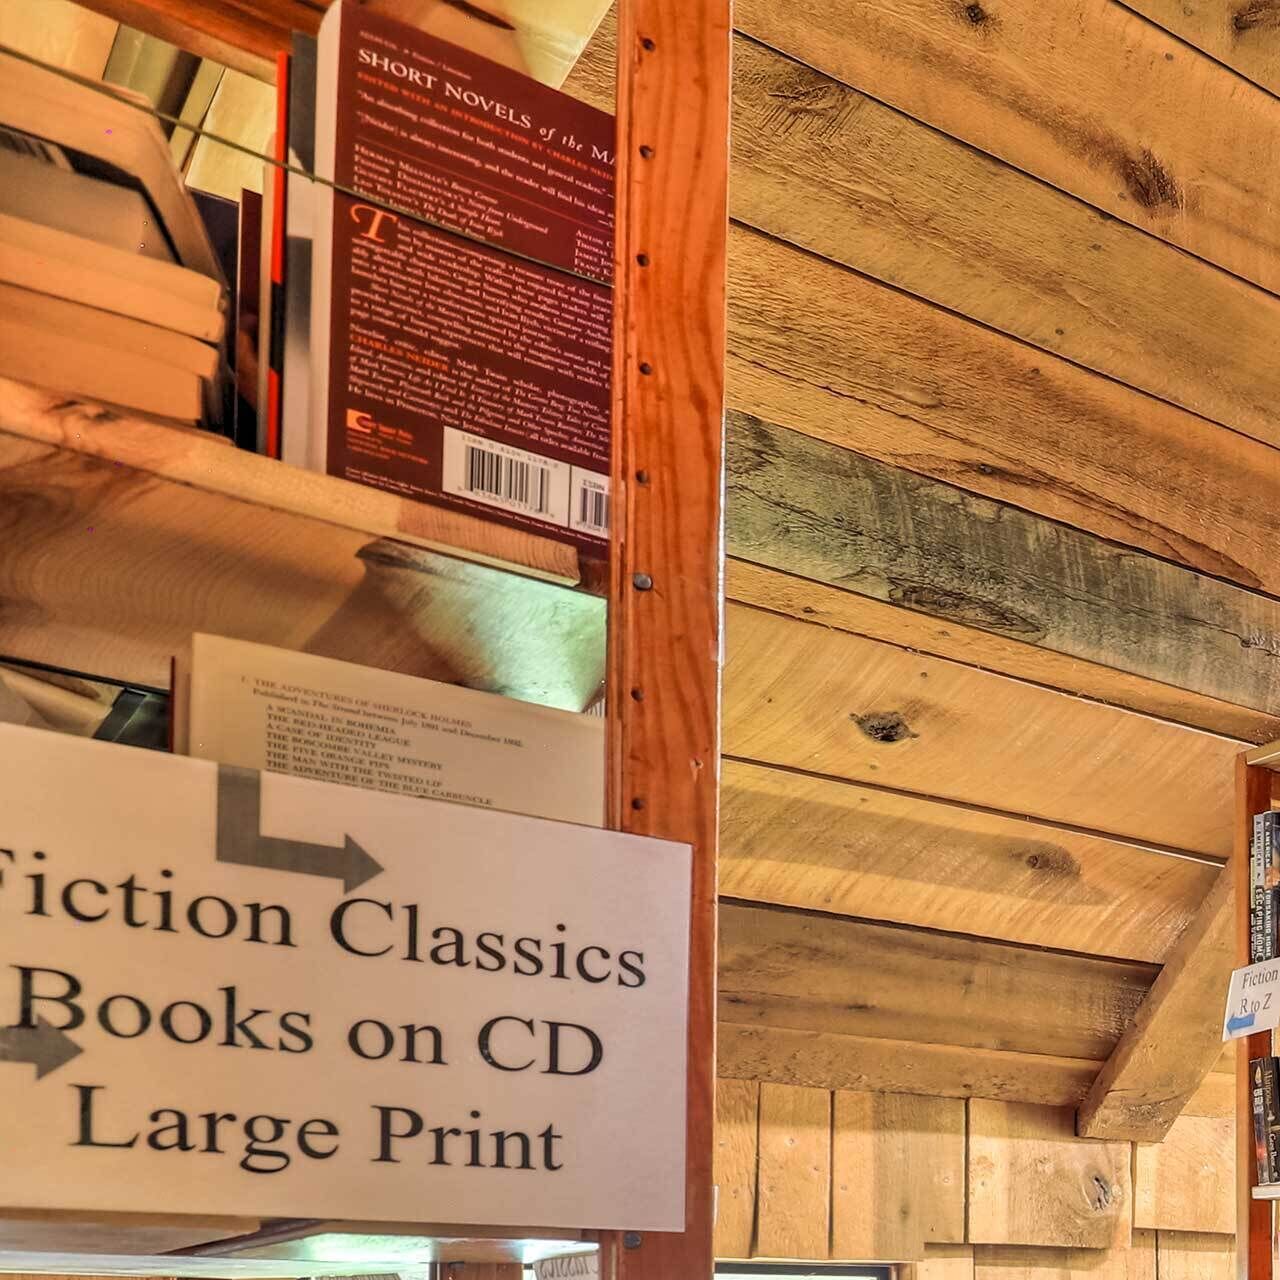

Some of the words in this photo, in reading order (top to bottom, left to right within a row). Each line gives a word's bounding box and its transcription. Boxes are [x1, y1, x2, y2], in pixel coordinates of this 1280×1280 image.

[357, 48, 438, 90] SHORT
[445, 82, 532, 129] NOVELS
[539, 126, 556, 142] of
[561, 134, 584, 152] the
[0, 848, 298, 948] iction
[330, 898, 647, 989] Classics
[8, 965, 314, 1054] Books
[347, 1017, 449, 1066] on
[477, 1015, 603, 1077] CD
[1240, 999, 1249, 1014] R
[1251, 998, 1260, 1012] to
[1263, 993, 1272, 1010] Z
[1242, 968, 1278, 989] Fiction
[67, 1084, 341, 1174] Large
[371, 1105, 564, 1172] Print
